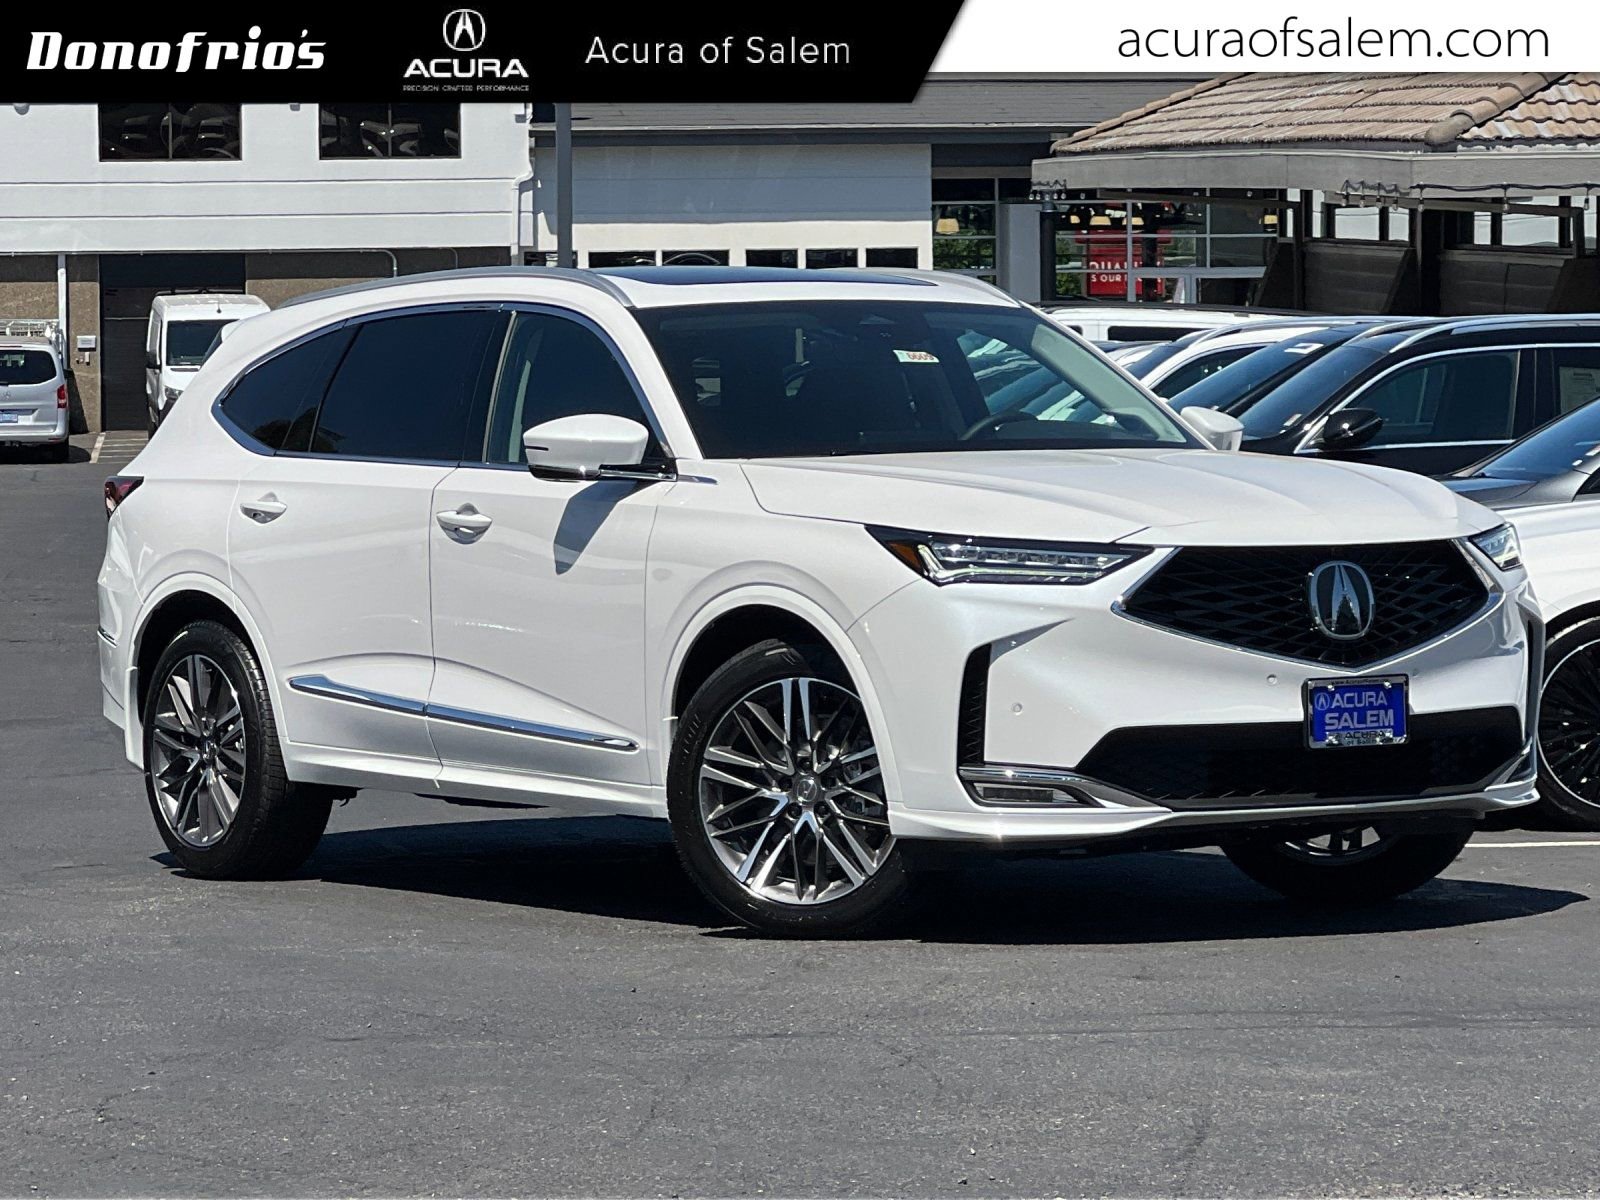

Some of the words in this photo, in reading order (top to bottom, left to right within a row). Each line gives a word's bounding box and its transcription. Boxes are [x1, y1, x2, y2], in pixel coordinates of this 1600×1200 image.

[1100, 274, 1121, 282] OUR
[1330, 691, 1387, 708] ACURA
[1325, 709, 1394, 730] SALEM
